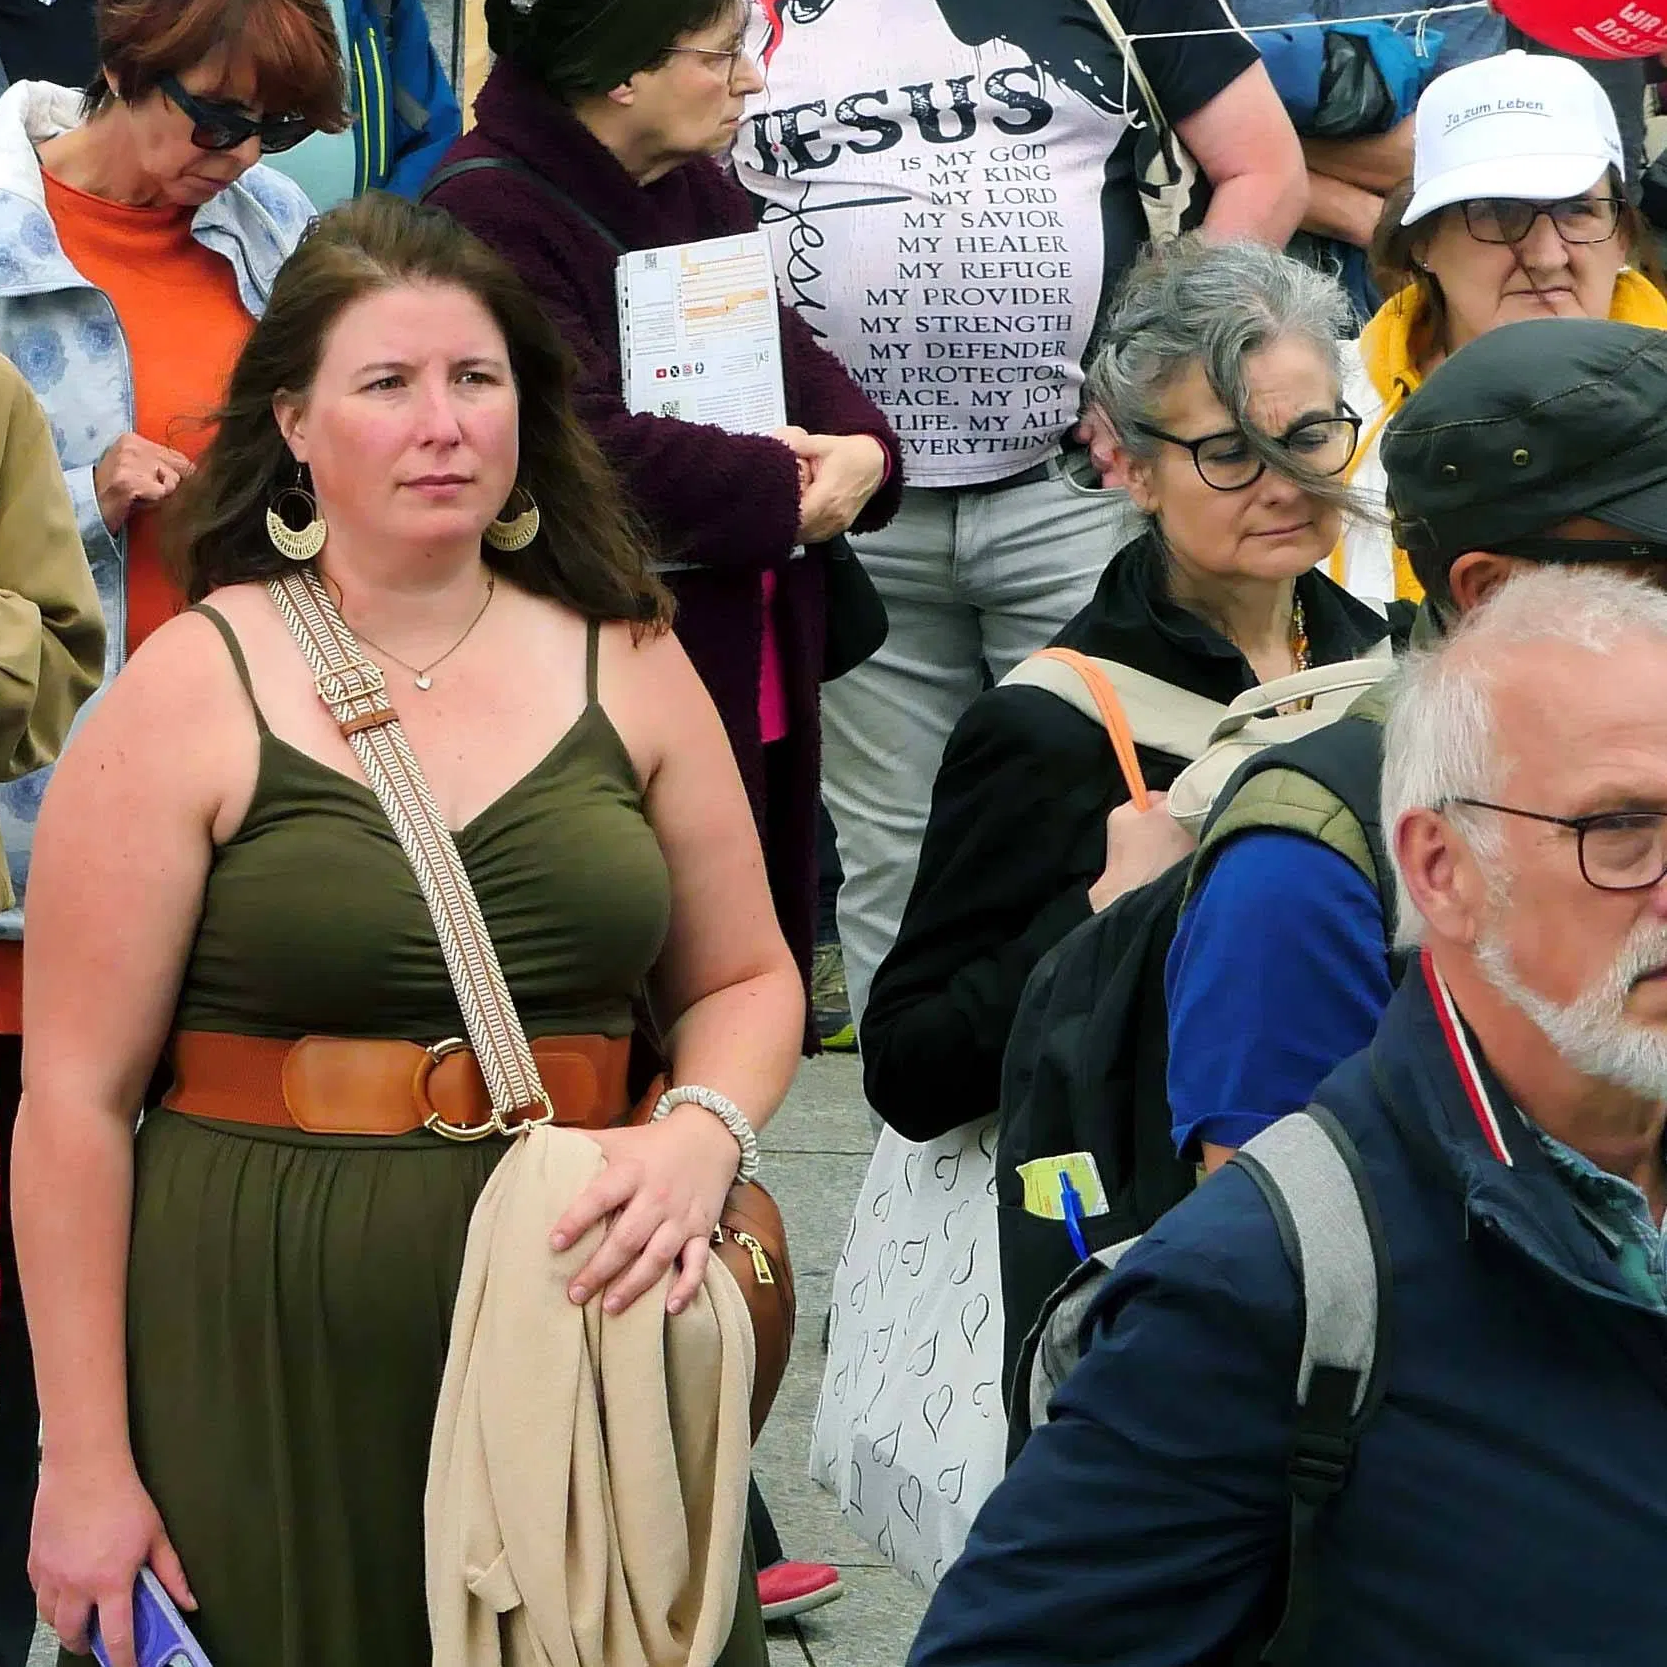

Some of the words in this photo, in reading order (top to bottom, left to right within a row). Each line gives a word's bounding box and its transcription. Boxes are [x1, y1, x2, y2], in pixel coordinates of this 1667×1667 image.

[1618, 1, 1662, 34] WIR
[1594, 17, 1640, 46] DAS
[744, 63, 1055, 177] JESUS
[1444, 112, 1461, 128] Ja
[1463, 103, 1491, 120] zum
[1497, 97, 1545, 111] Leben
[899, 155, 922, 172] IS
[935, 149, 978, 168] MY
[989, 143, 1048, 163] GOD
[928, 168, 976, 187] MY
[983, 164, 1052, 183] KING
[930, 188, 975, 207] MY
[986, 187, 1058, 206] LORD
[902, 211, 947, 230] MY
[960, 210, 1066, 229] SAVIOR
[896, 234, 945, 254] MY
[954, 235, 1070, 254] HEALER
[896, 260, 945, 281] MY
[961, 260, 1074, 280] REFUGE
[865, 287, 909, 308] MY
[923, 286, 1074, 307] PROVIDER
[859, 314, 903, 336] MY
[915, 313, 1073, 334] STRENGTH
[869, 341, 914, 362] MY
[925, 339, 1068, 361] DEFENDER
[851, 366, 888, 386] MY
[901, 364, 1069, 385] PROTECTOR
[865, 387, 960, 407] PEACE.
[970, 388, 1014, 409] MY
[1023, 383, 1066, 409] JOY
[894, 414, 960, 433] LIFE.
[967, 413, 1011, 434] MY
[1021, 410, 1066, 431] ALL
